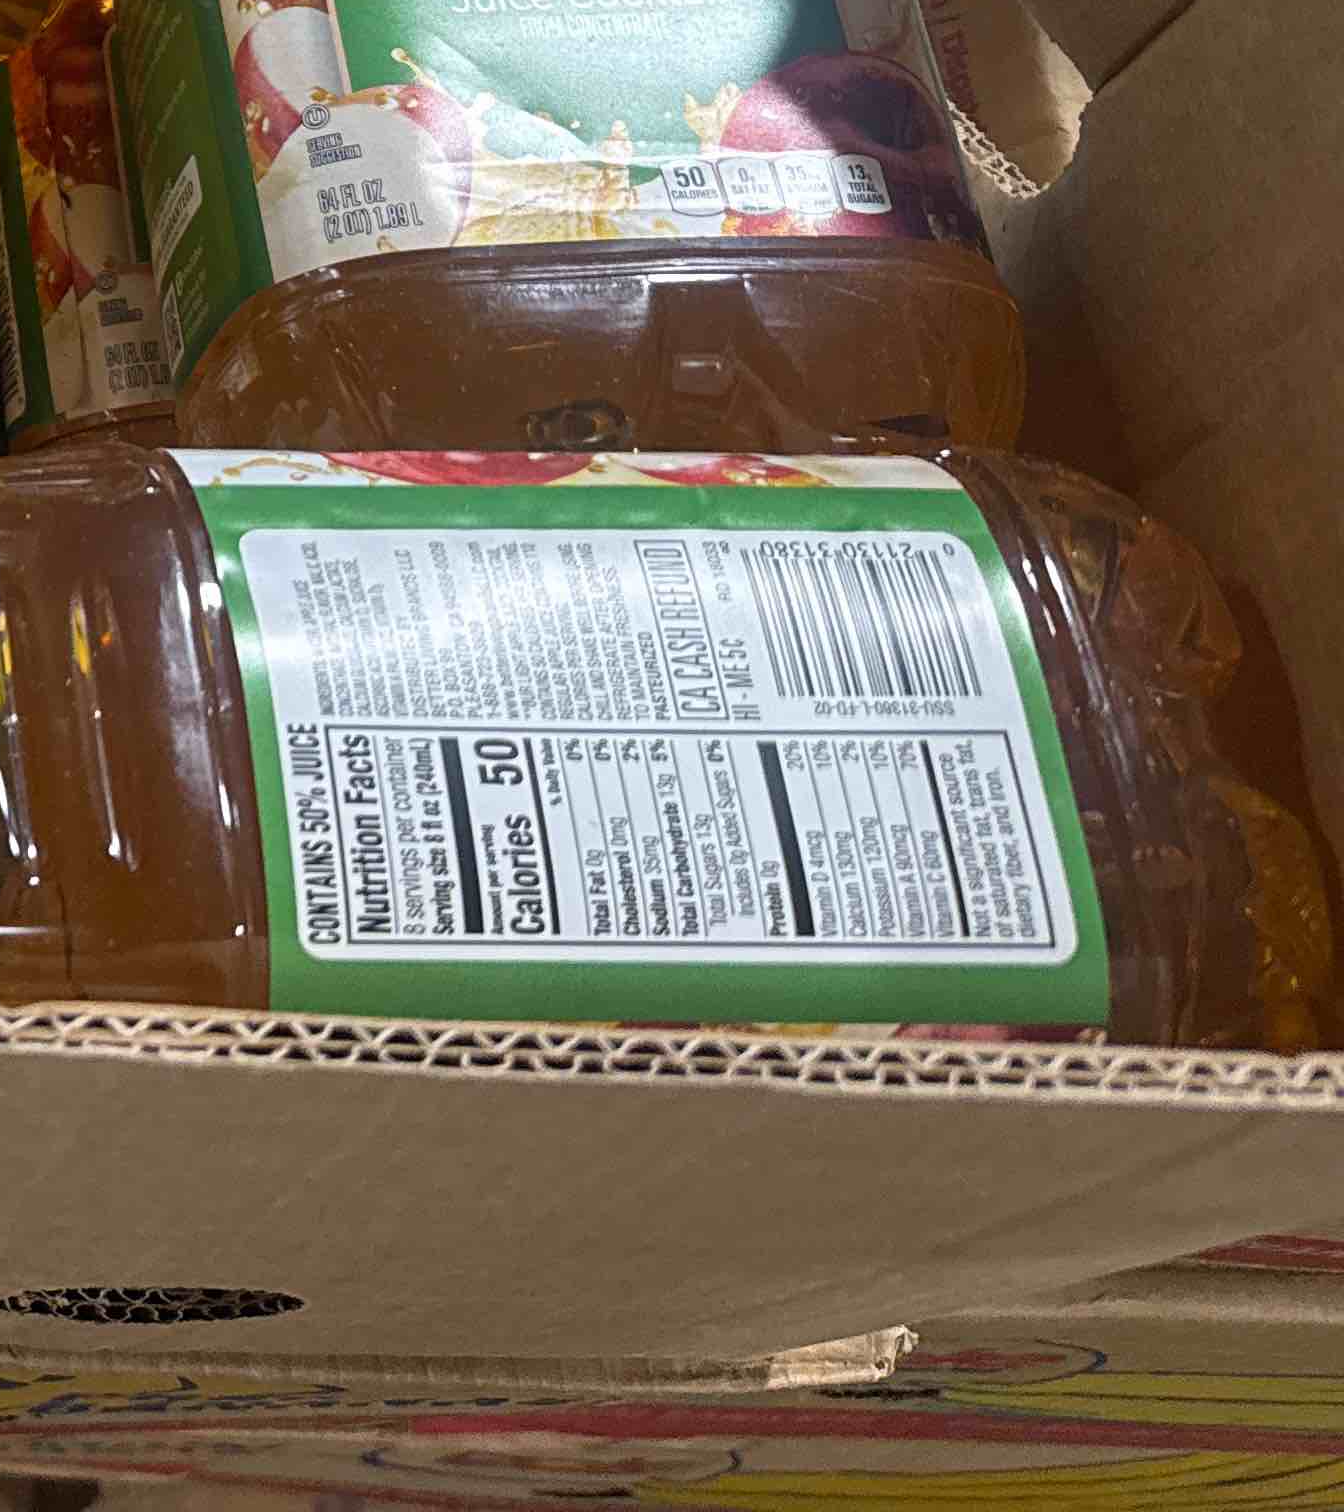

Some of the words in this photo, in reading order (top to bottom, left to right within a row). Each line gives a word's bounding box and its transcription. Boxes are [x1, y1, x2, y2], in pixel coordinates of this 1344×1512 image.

[317, 187, 339, 214] 64
[340, 183, 361, 208] FL
[362, 178, 386, 204] OZ
[674, 165, 705, 188] 50
[323, 214, 342, 244] (2
[373, 203, 410, 230] 1.89
[412, 202, 423, 226] L
[643, 548, 700, 620] REFUND
[664, 628, 713, 678] CASH
[723, 664, 753, 688] ME
[679, 686, 721, 712] CA
[732, 704, 760, 720] HI
[288, 724, 323, 781] JUICE
[339, 735, 378, 804] Facts
[474, 738, 524, 786] 50
[298, 788, 330, 833] 50%
[302, 840, 341, 944] CONTAINS
[351, 815, 391, 933] Nutrition
[503, 814, 545, 934] Calories
